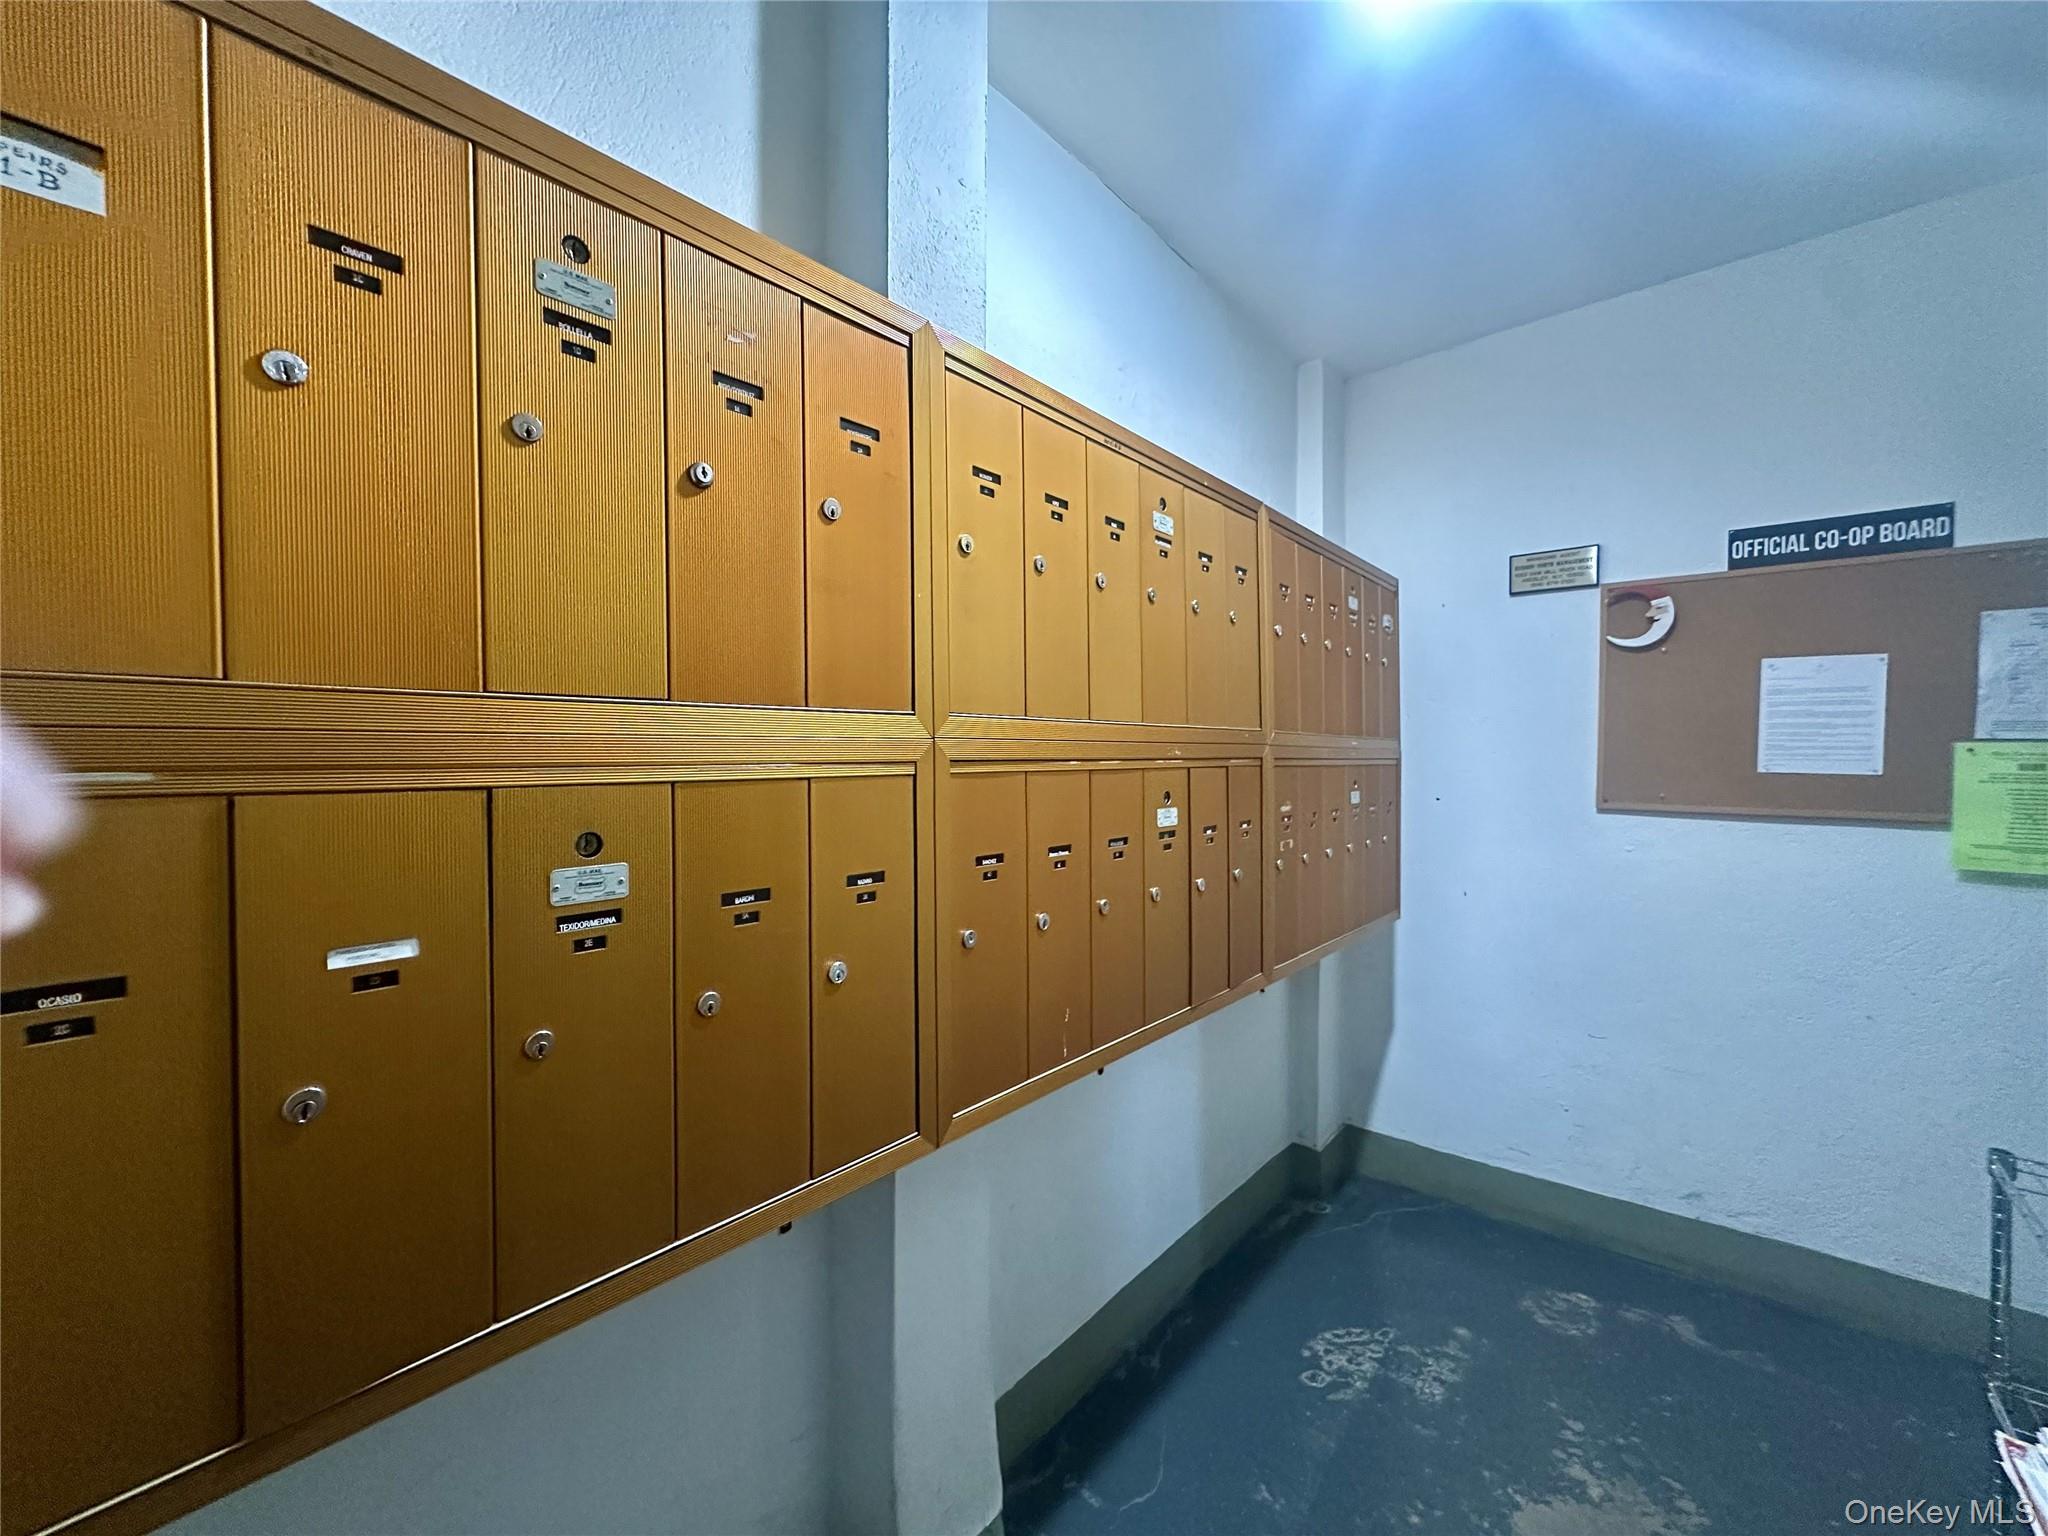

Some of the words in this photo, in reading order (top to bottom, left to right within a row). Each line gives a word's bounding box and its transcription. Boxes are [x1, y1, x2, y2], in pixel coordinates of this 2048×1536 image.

[340, 244, 373, 262] CRAVEN
[1731, 533, 1810, 560] OFFICIAL
[1814, 525, 1875, 550] CO-OP
[1879, 516, 1951, 543] BOARD
[37, 993, 83, 1009] OCASIO
